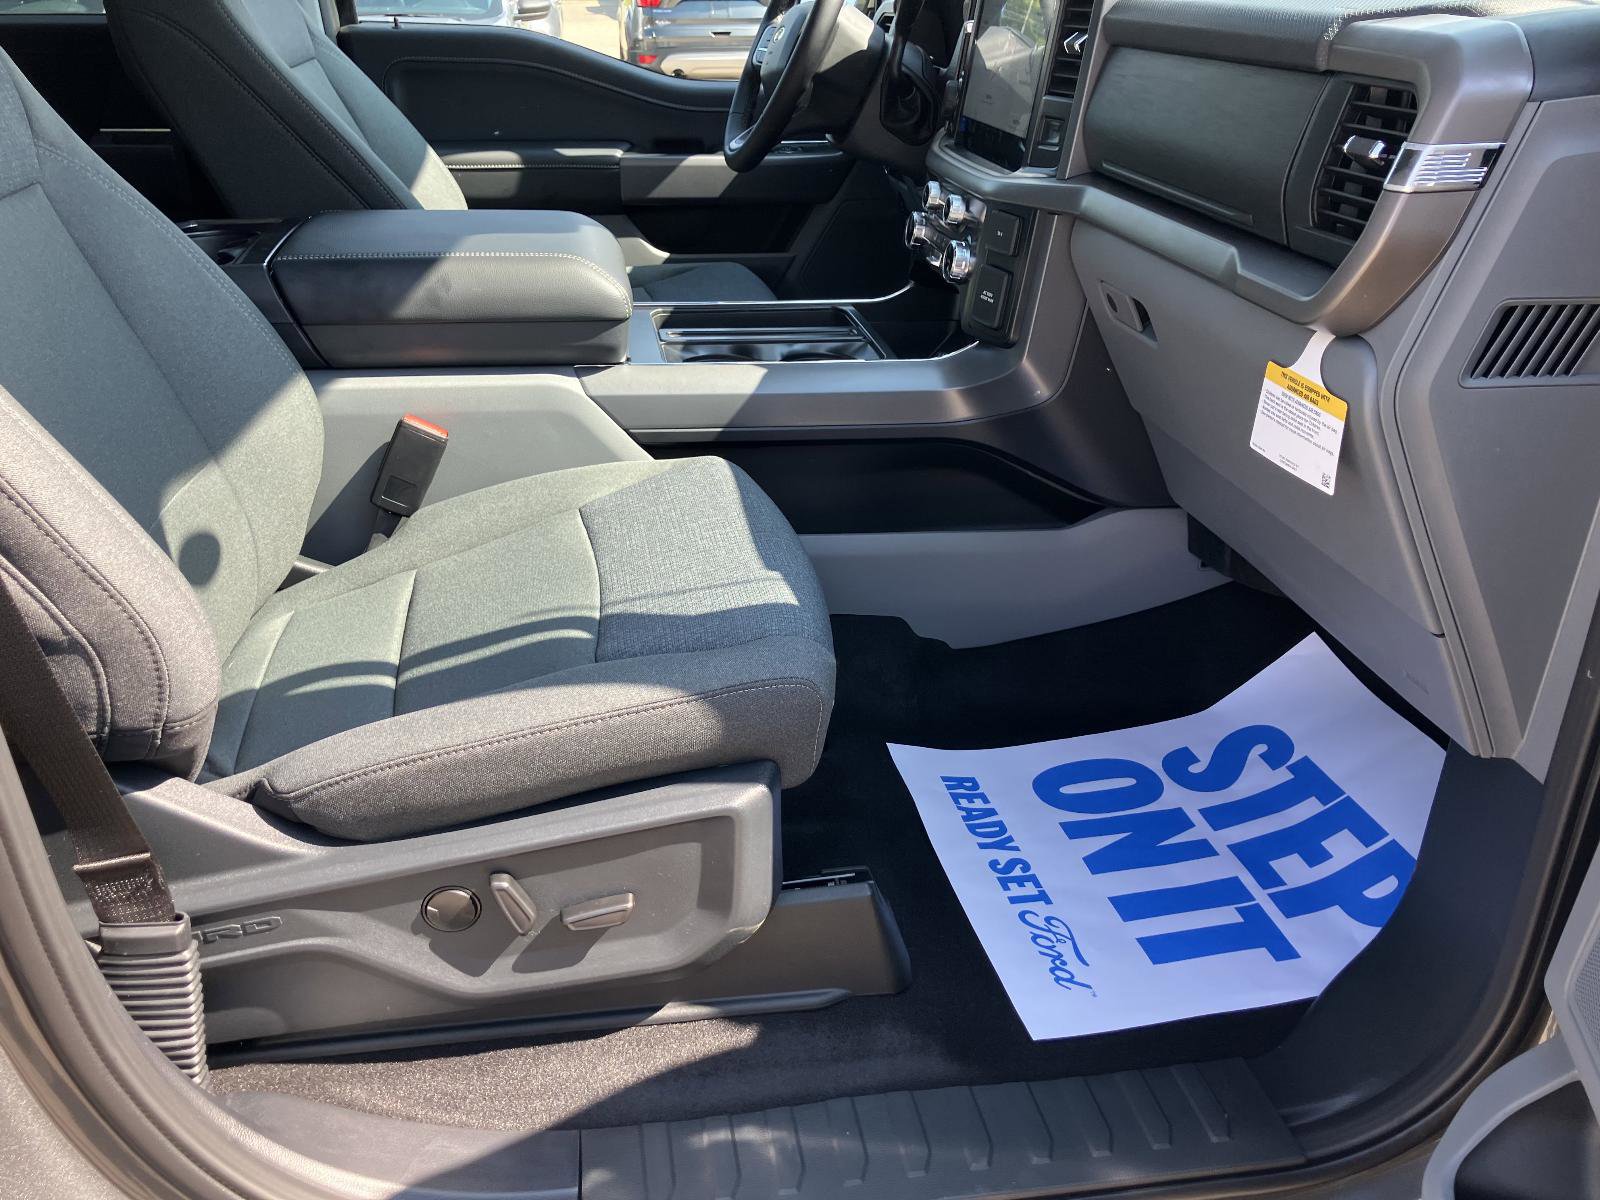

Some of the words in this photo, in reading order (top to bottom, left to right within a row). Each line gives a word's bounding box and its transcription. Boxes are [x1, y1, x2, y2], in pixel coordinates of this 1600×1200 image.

[940, 775, 1021, 851] READY
[1032, 758, 1218, 875] ON
[1162, 725, 1417, 928] STEP
[988, 857, 1053, 905] SET
[1107, 876, 1302, 965] IT
[192, 916, 283, 943] RD
[1018, 909, 1092, 990] Ford
